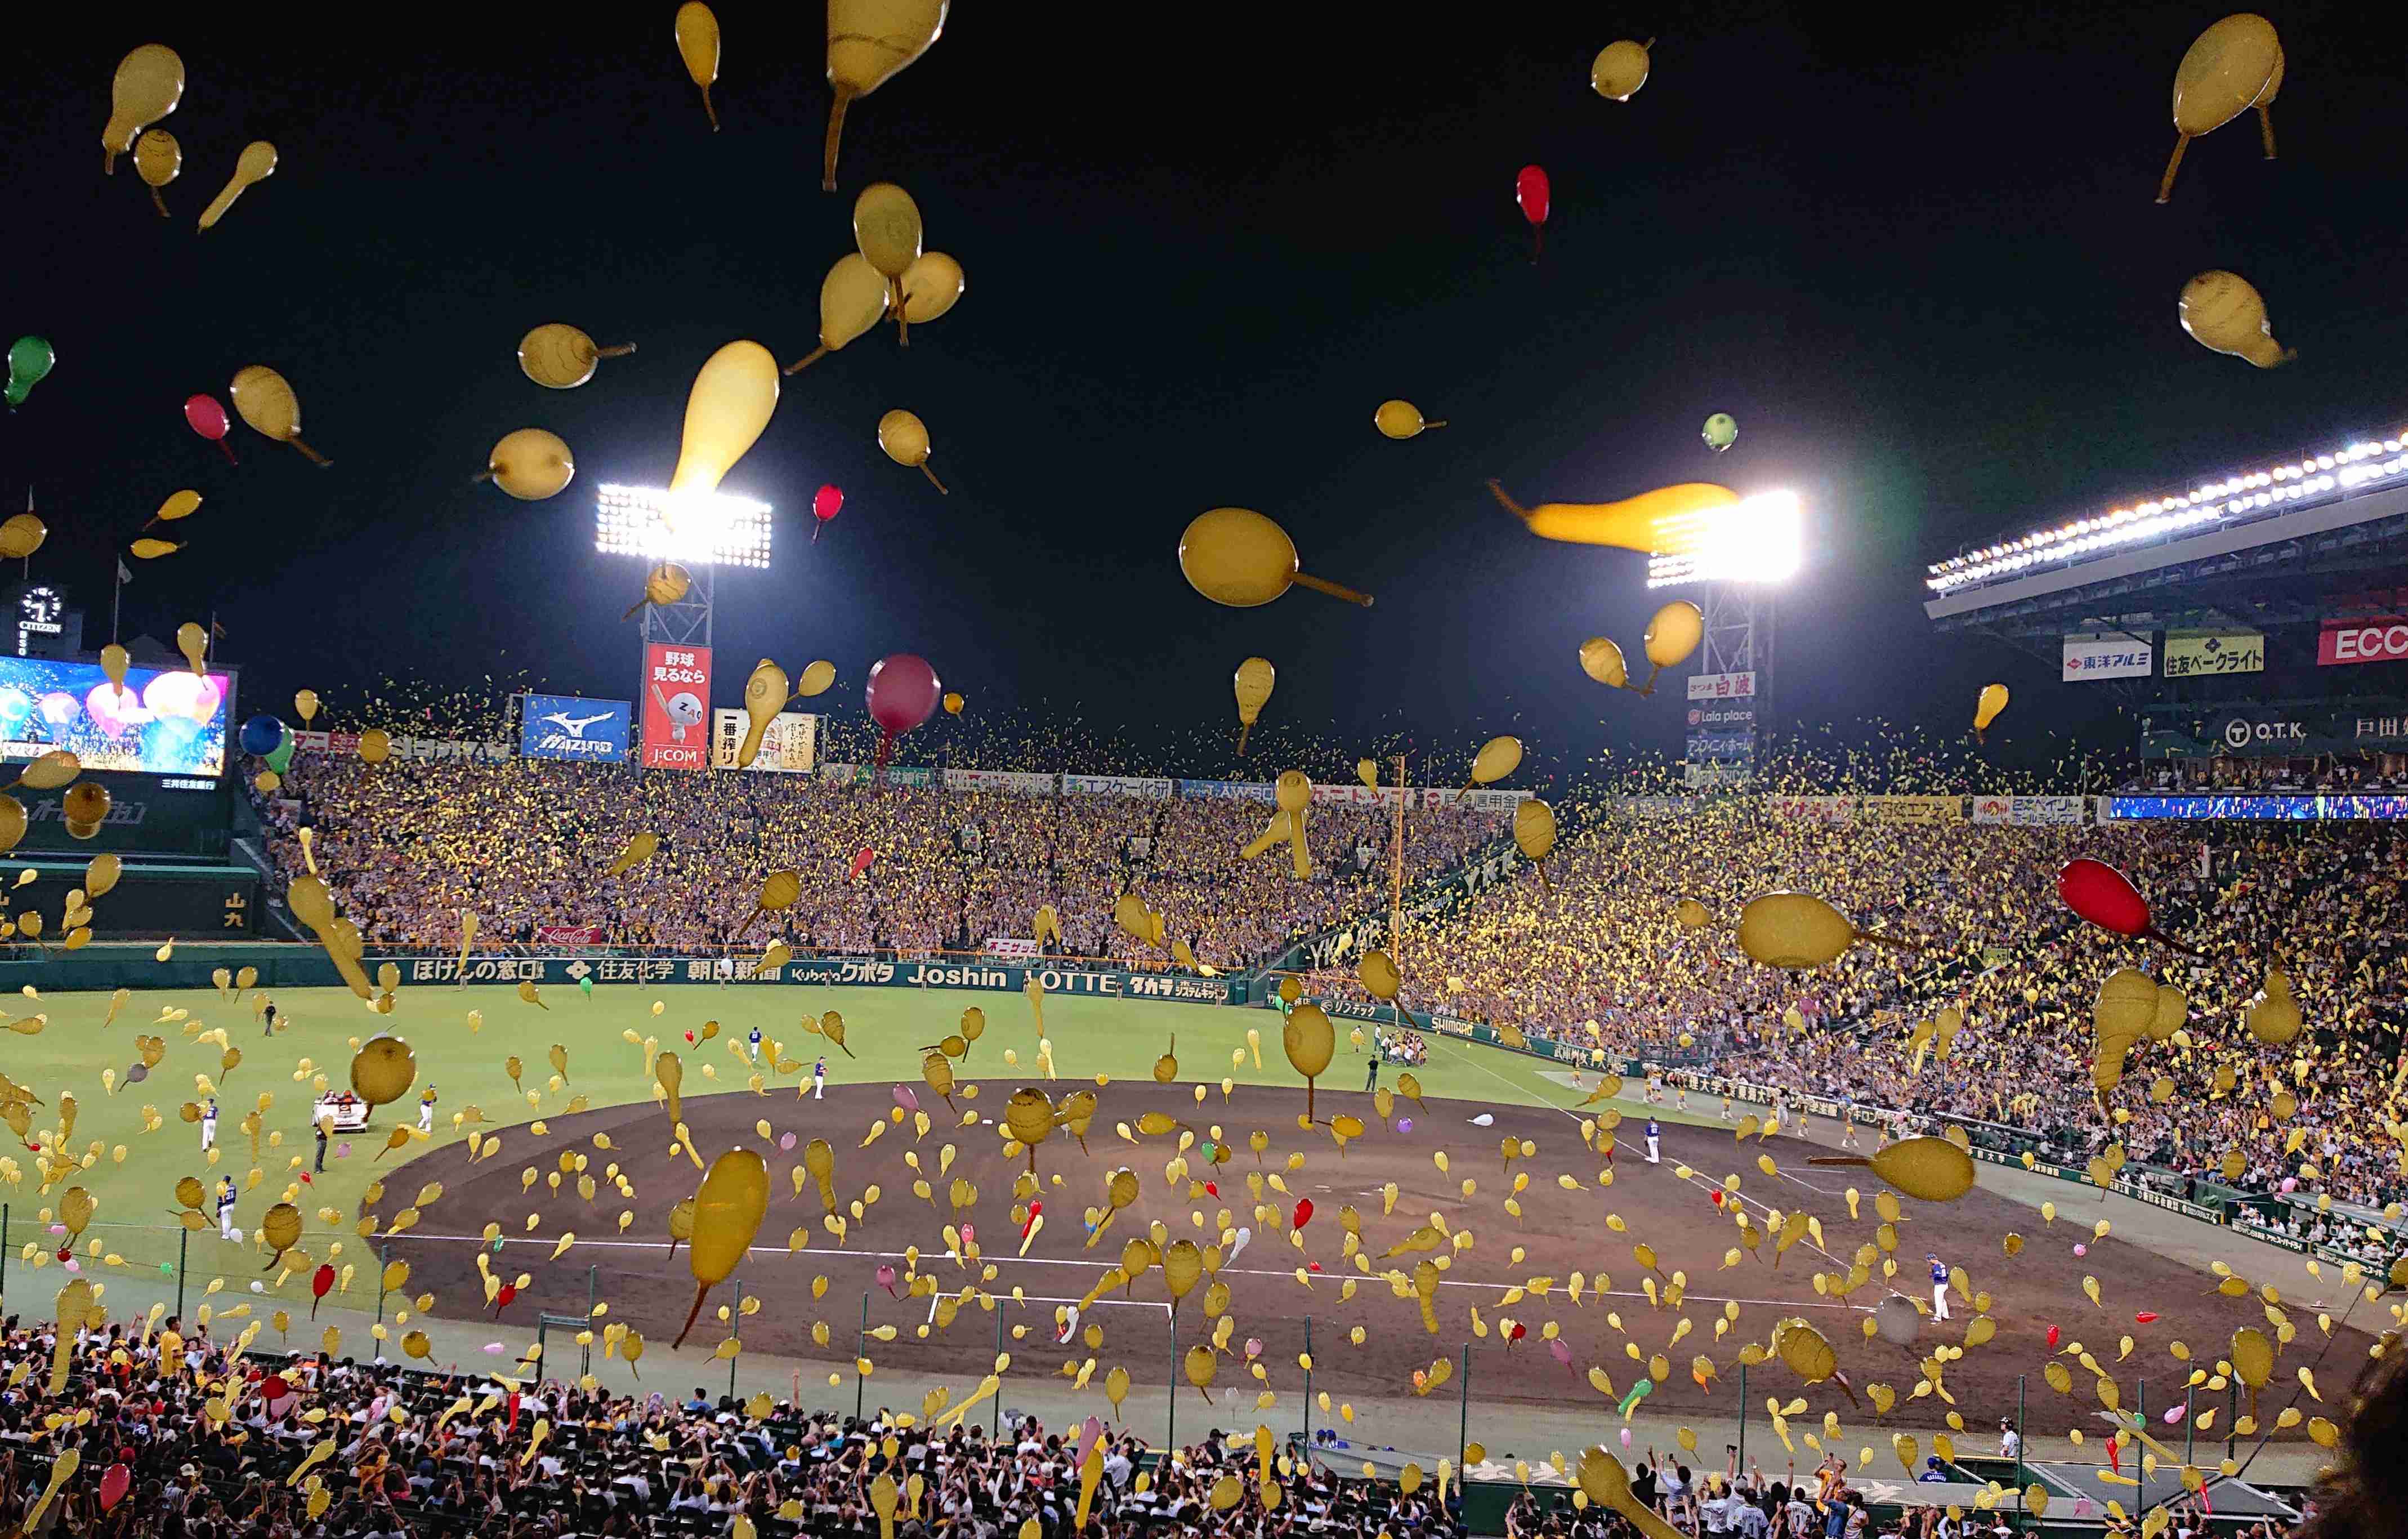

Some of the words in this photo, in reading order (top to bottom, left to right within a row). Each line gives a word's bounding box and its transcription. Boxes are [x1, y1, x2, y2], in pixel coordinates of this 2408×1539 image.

[19, 621, 62, 633] CITIZEN
[2336, 625, 2408, 659] ECC
[665, 652, 695, 667] 野球
[2083, 653, 2149, 669] 東洋アルミ
[2166, 650, 2262, 675] 住友ベークライト
[653, 667, 706, 684] 見るなら
[1702, 711, 1721, 722] Lala
[1723, 710, 1753, 725] place
[722, 716, 738, 765] 一番搾り
[652, 750, 697, 763] J:COM
[1205, 783, 1277, 800] LAWSO
[225, 892, 245, 928] 山九
[413, 960, 537, 981] ほけんの窓口
[597, 960, 674, 981] 住友化学
[840, 962, 895, 983] クボタ
[907, 965, 1007, 988] Joshin
[1129, 976, 1173, 996] タカラ
[1335, 1002, 1375, 1017] リフテック
